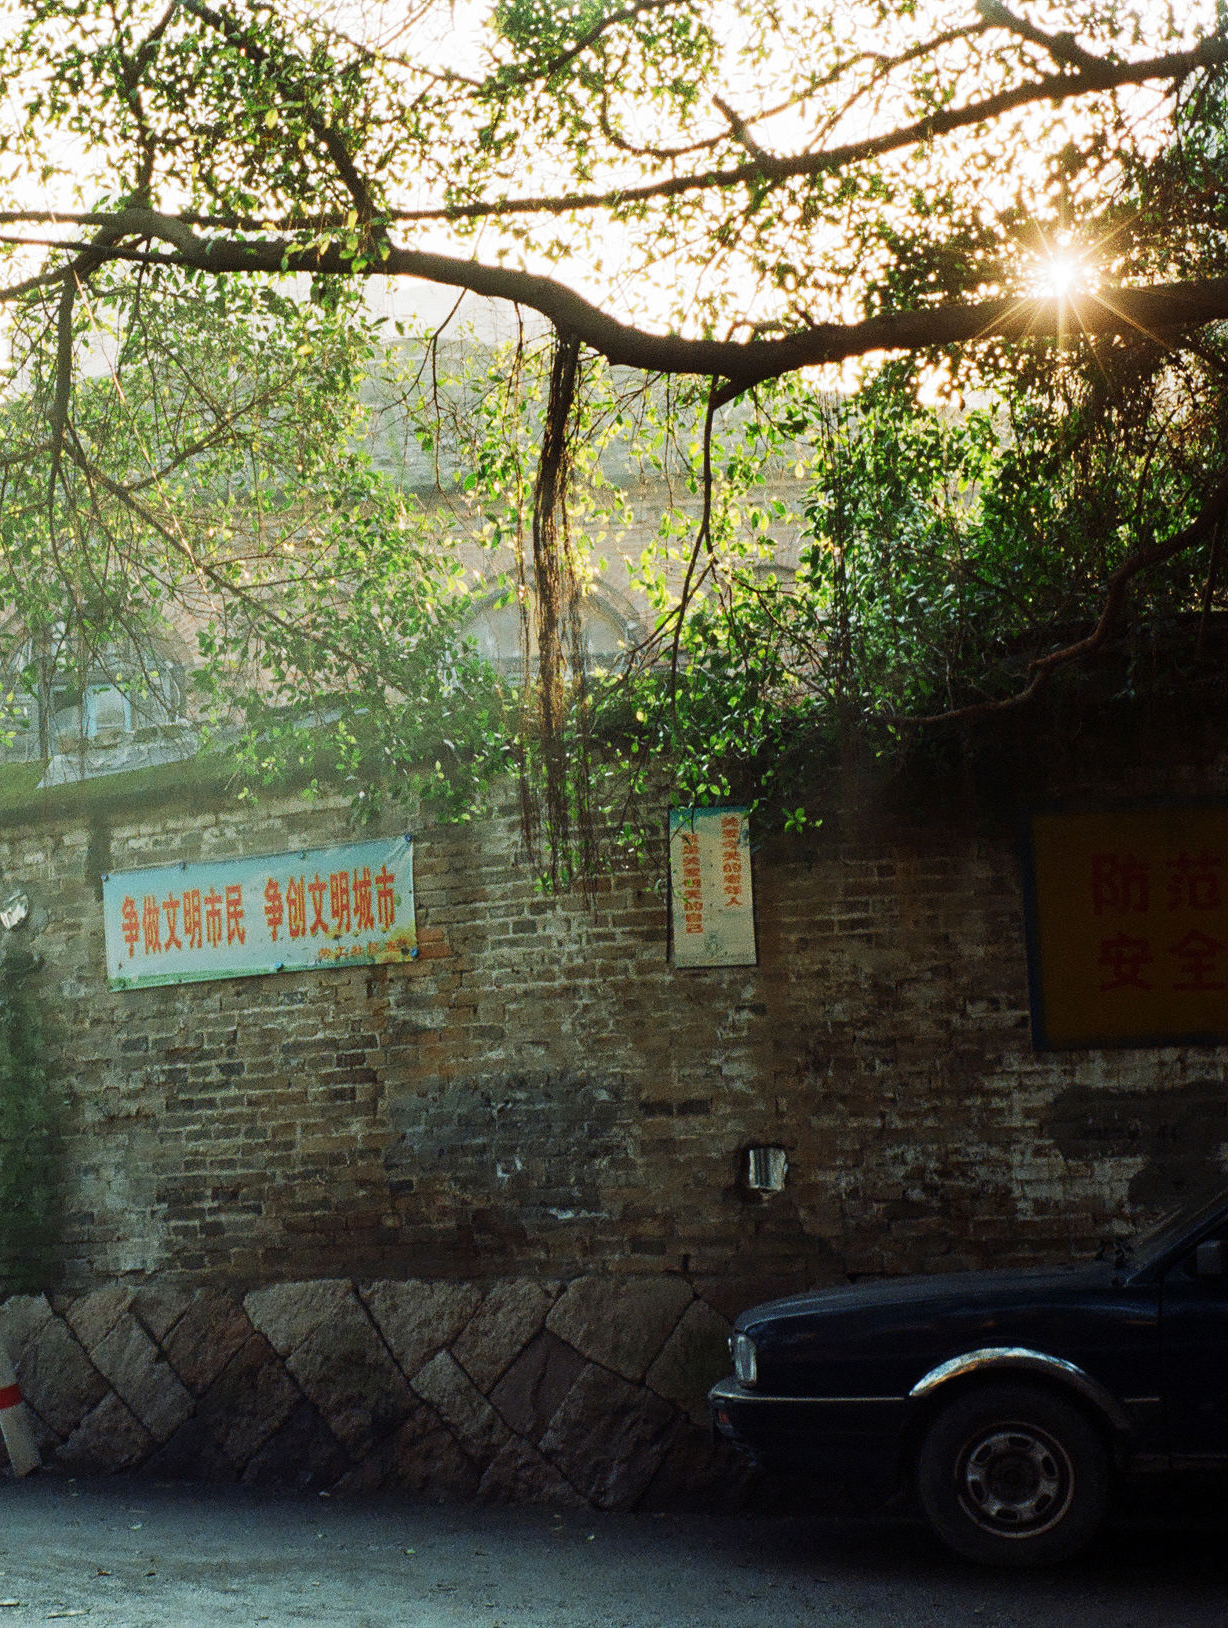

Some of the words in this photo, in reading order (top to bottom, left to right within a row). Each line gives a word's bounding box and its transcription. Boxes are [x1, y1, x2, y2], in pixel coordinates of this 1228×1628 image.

[120, 883, 246, 959] 争做文明市民
[263, 863, 396, 942] 争创文明城市
[1091, 850, 1222, 916] 防范
[1097, 928, 1227, 993] 安全
